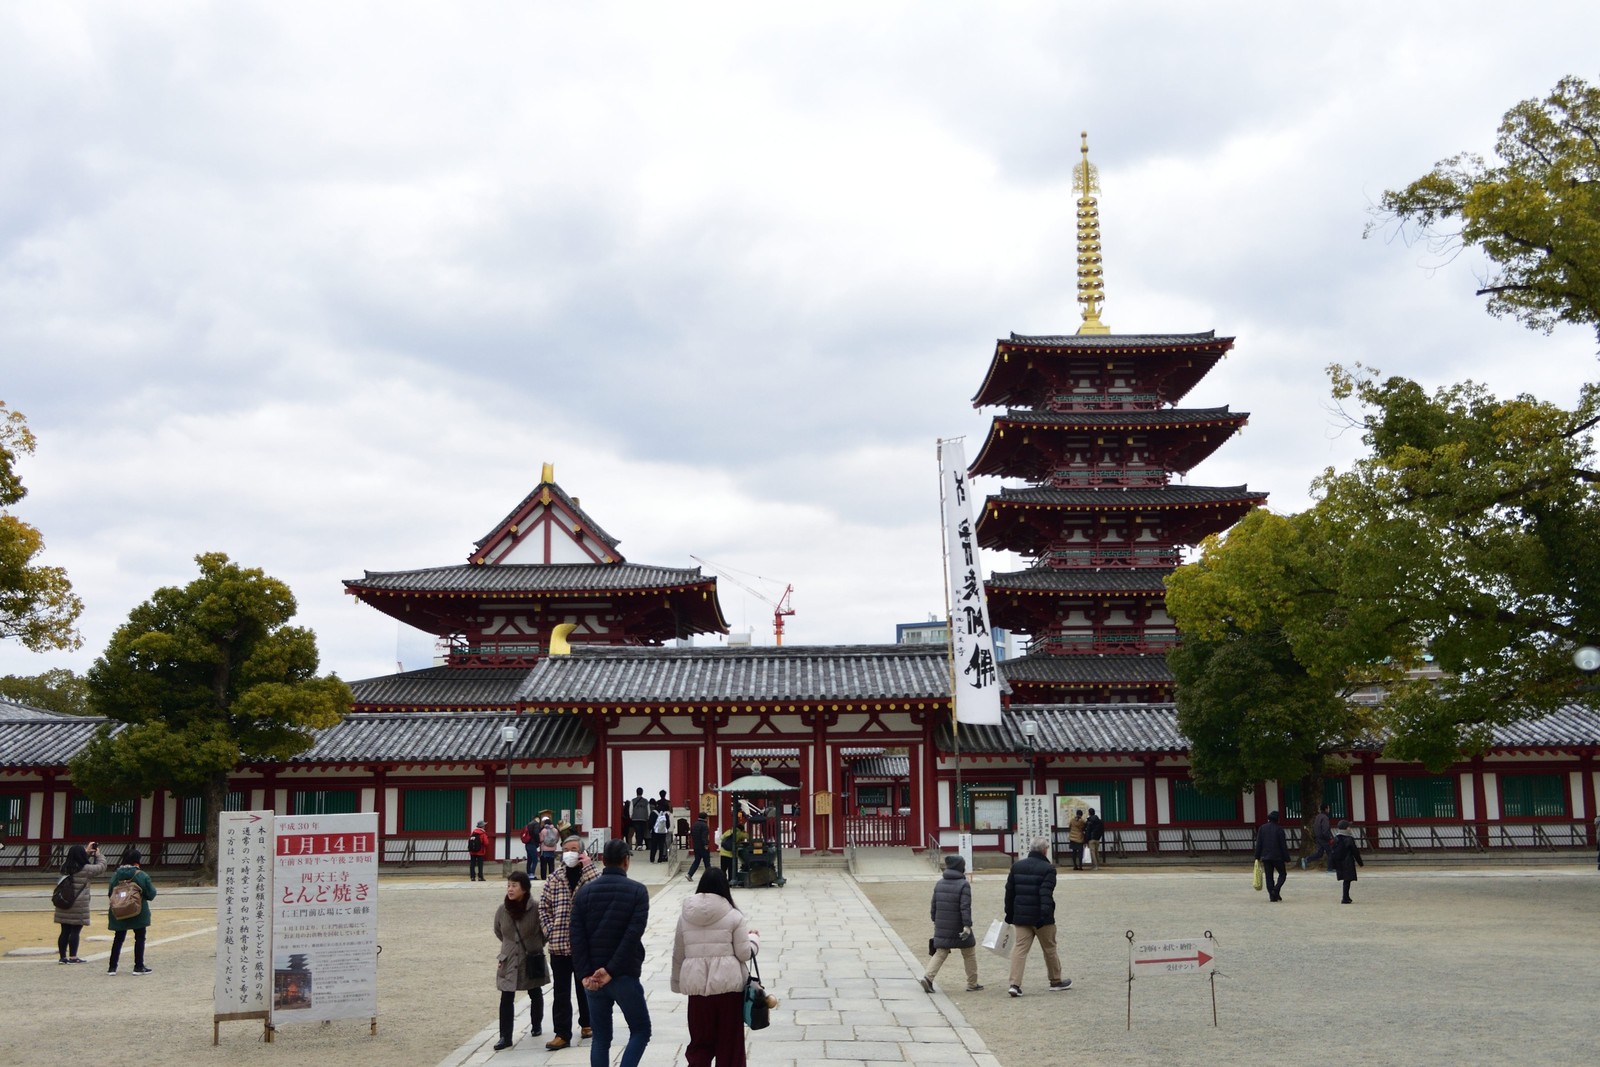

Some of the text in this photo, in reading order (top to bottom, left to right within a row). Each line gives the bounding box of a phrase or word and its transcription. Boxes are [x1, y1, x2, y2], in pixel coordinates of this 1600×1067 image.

[279, 822, 319, 831] 平成30年
[283, 835, 367, 854] 1月14日
[301, 871, 349, 883] 四天王寺
[282, 883, 369, 904] とんど焼き
[282, 906, 370, 918] 仁王門前広場にて厳修
